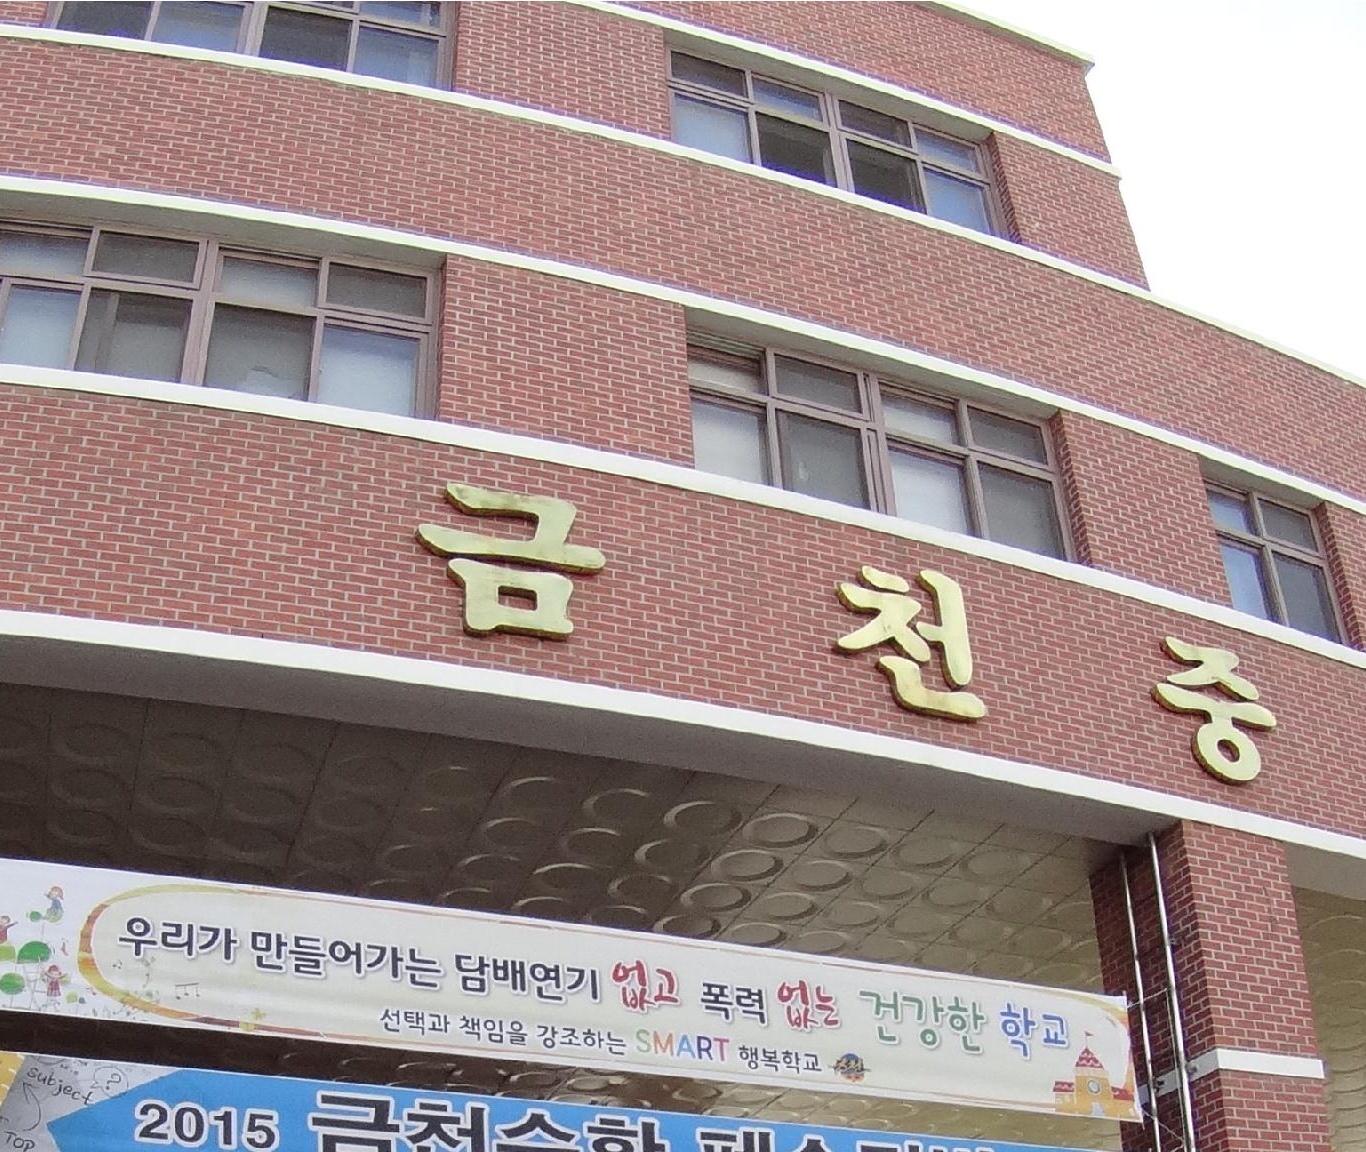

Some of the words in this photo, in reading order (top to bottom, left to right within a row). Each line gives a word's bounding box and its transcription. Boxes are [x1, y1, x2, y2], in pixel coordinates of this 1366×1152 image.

[118, 916, 241, 961] 우리가
[249, 935, 441, 987] 만들어가는
[453, 953, 601, 1002] 담배연기
[611, 959, 680, 1012] 없고
[700, 983, 767, 1027] 폭력
[776, 980, 841, 1030] 없는
[859, 988, 985, 1051] 건강한
[998, 1003, 1069, 1059] 학교
[380, 1008, 451, 1038] 선택과
[458, 1013, 528, 1046] 책임을
[535, 1022, 627, 1056] 강조하는
[635, 1032, 730, 1064] SMART
[738, 1045, 821, 1076] 행복학교
[26, 1067, 93, 1105] subject
[137, 1103, 279, 1150] 2015
